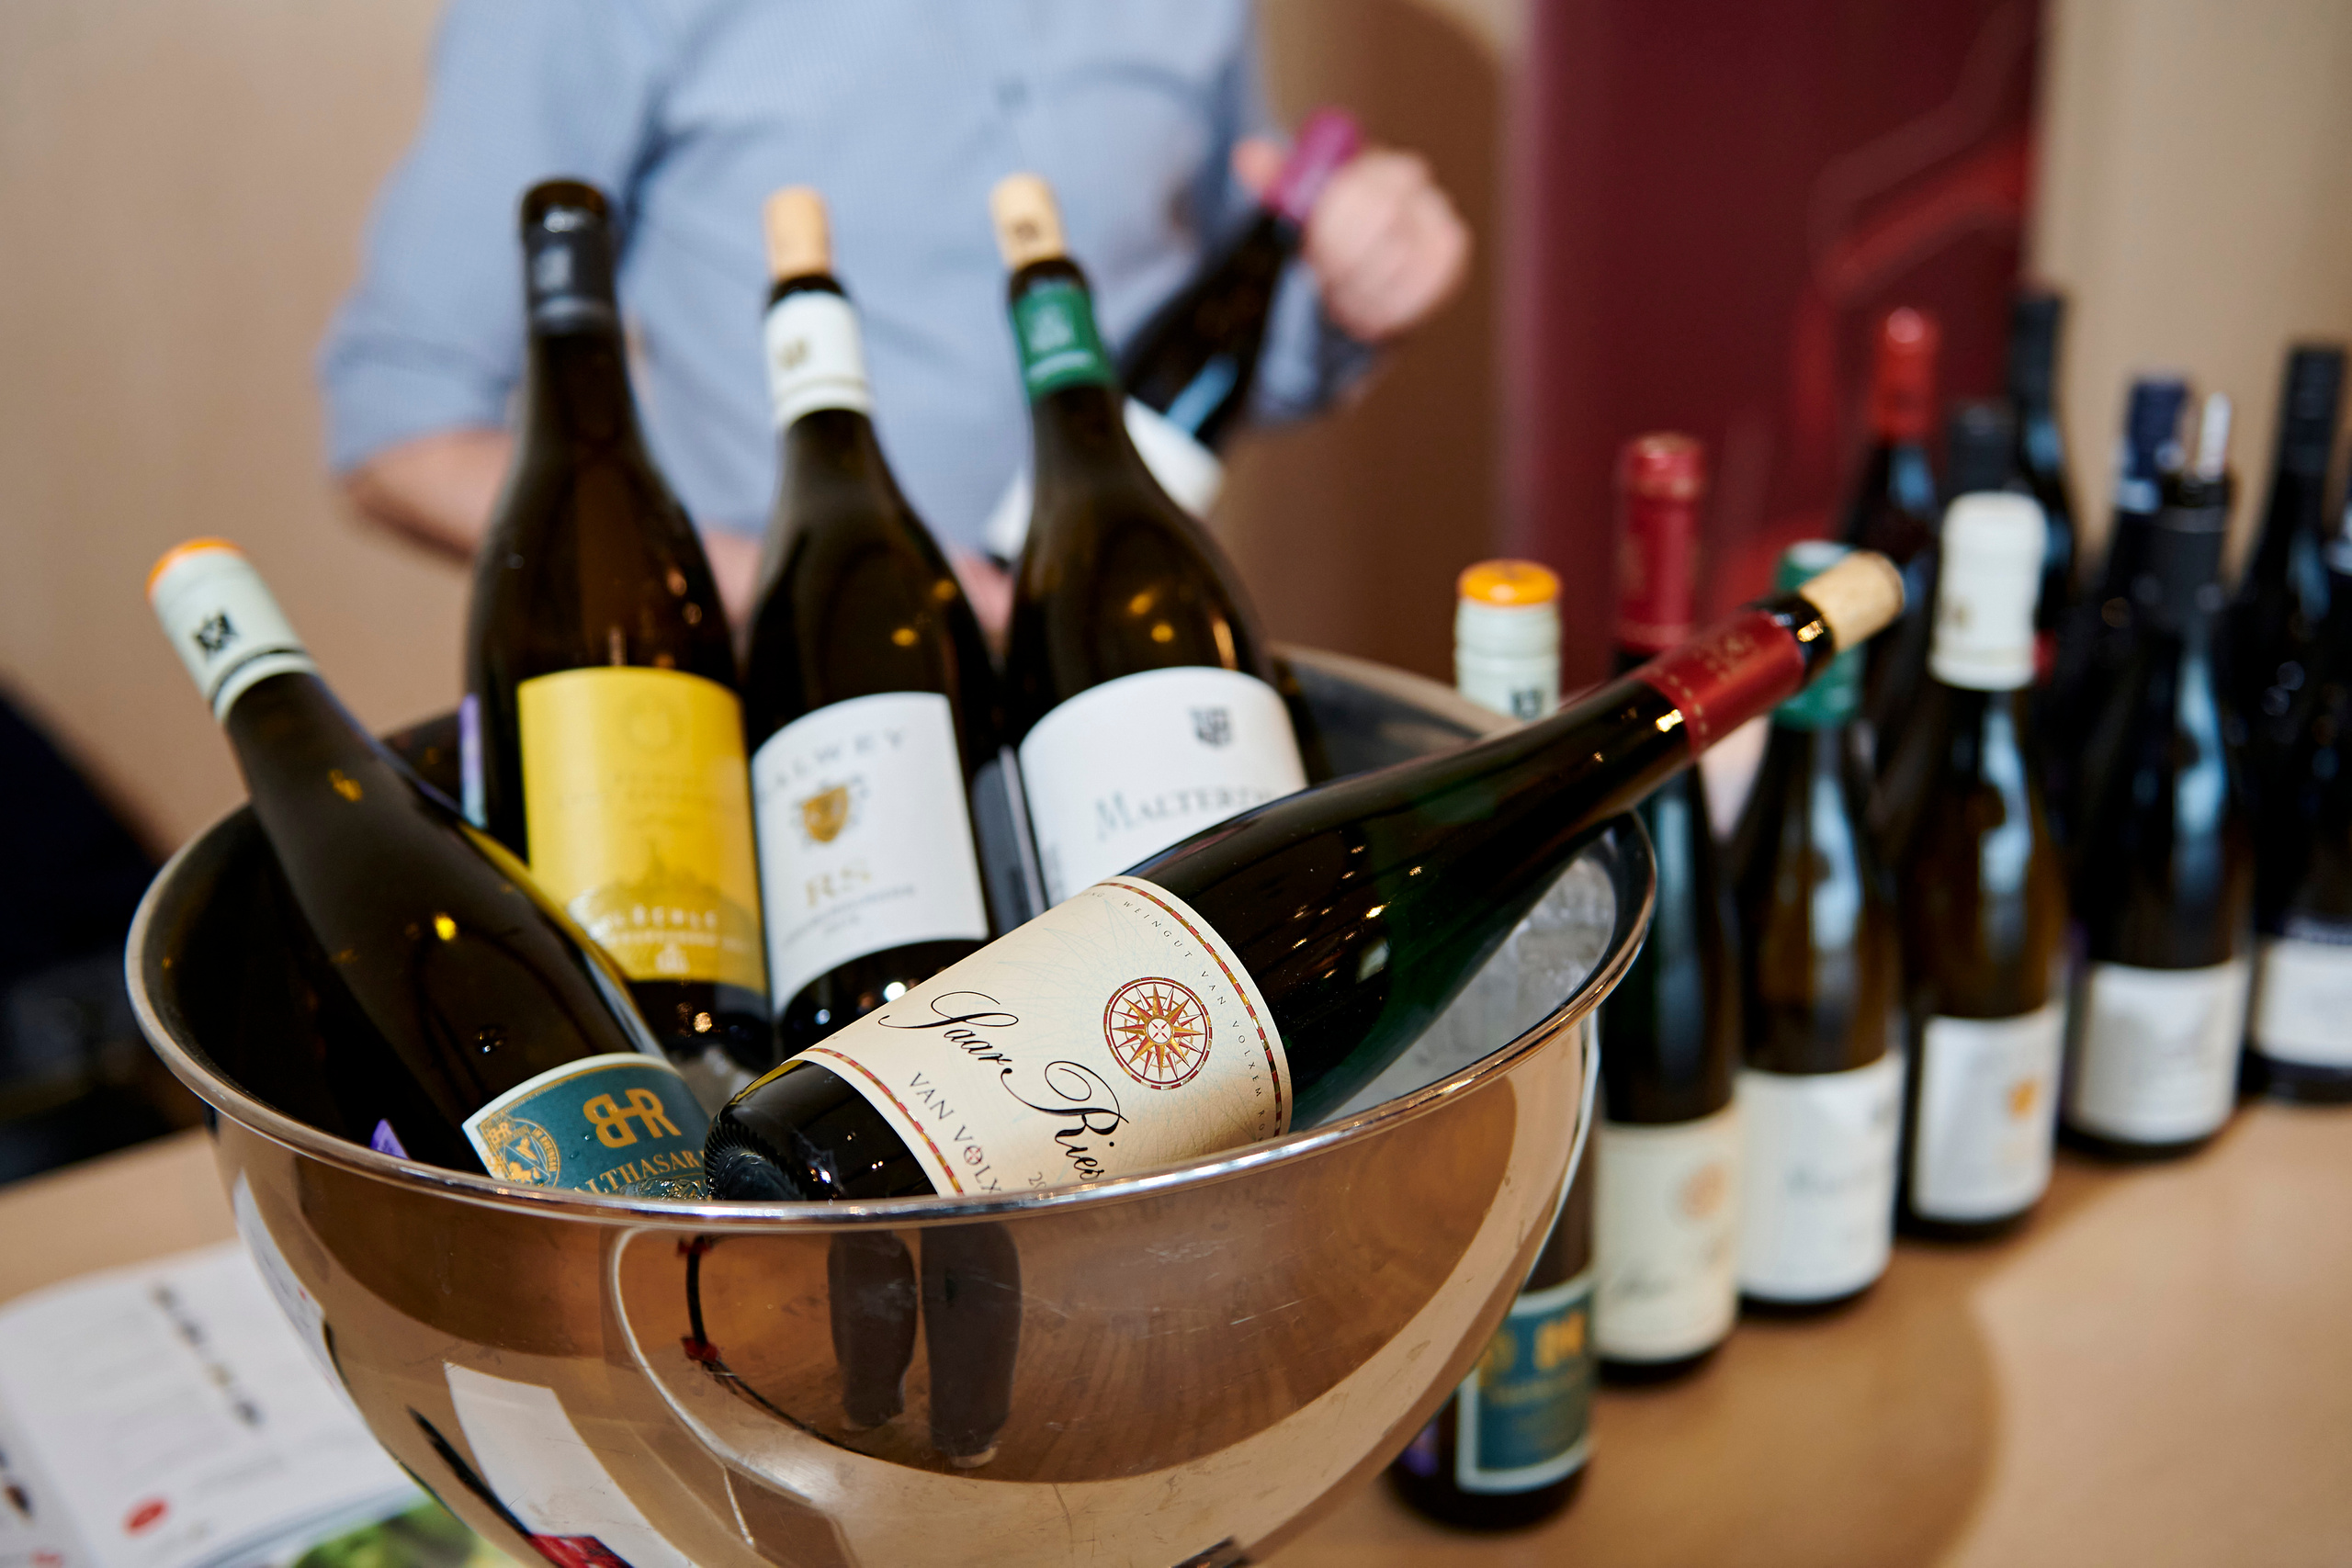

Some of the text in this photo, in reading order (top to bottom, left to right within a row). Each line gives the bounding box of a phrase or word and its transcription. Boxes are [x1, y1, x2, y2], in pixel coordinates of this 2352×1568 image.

[878, 990, 1019, 1066] Saar
[1124, 901, 1193, 958] WEINGUT
[1201, 970, 1227, 1006] VAN
[1232, 1020, 1261, 1097] VOLXEM
[910, 1072, 955, 1121] VAN
